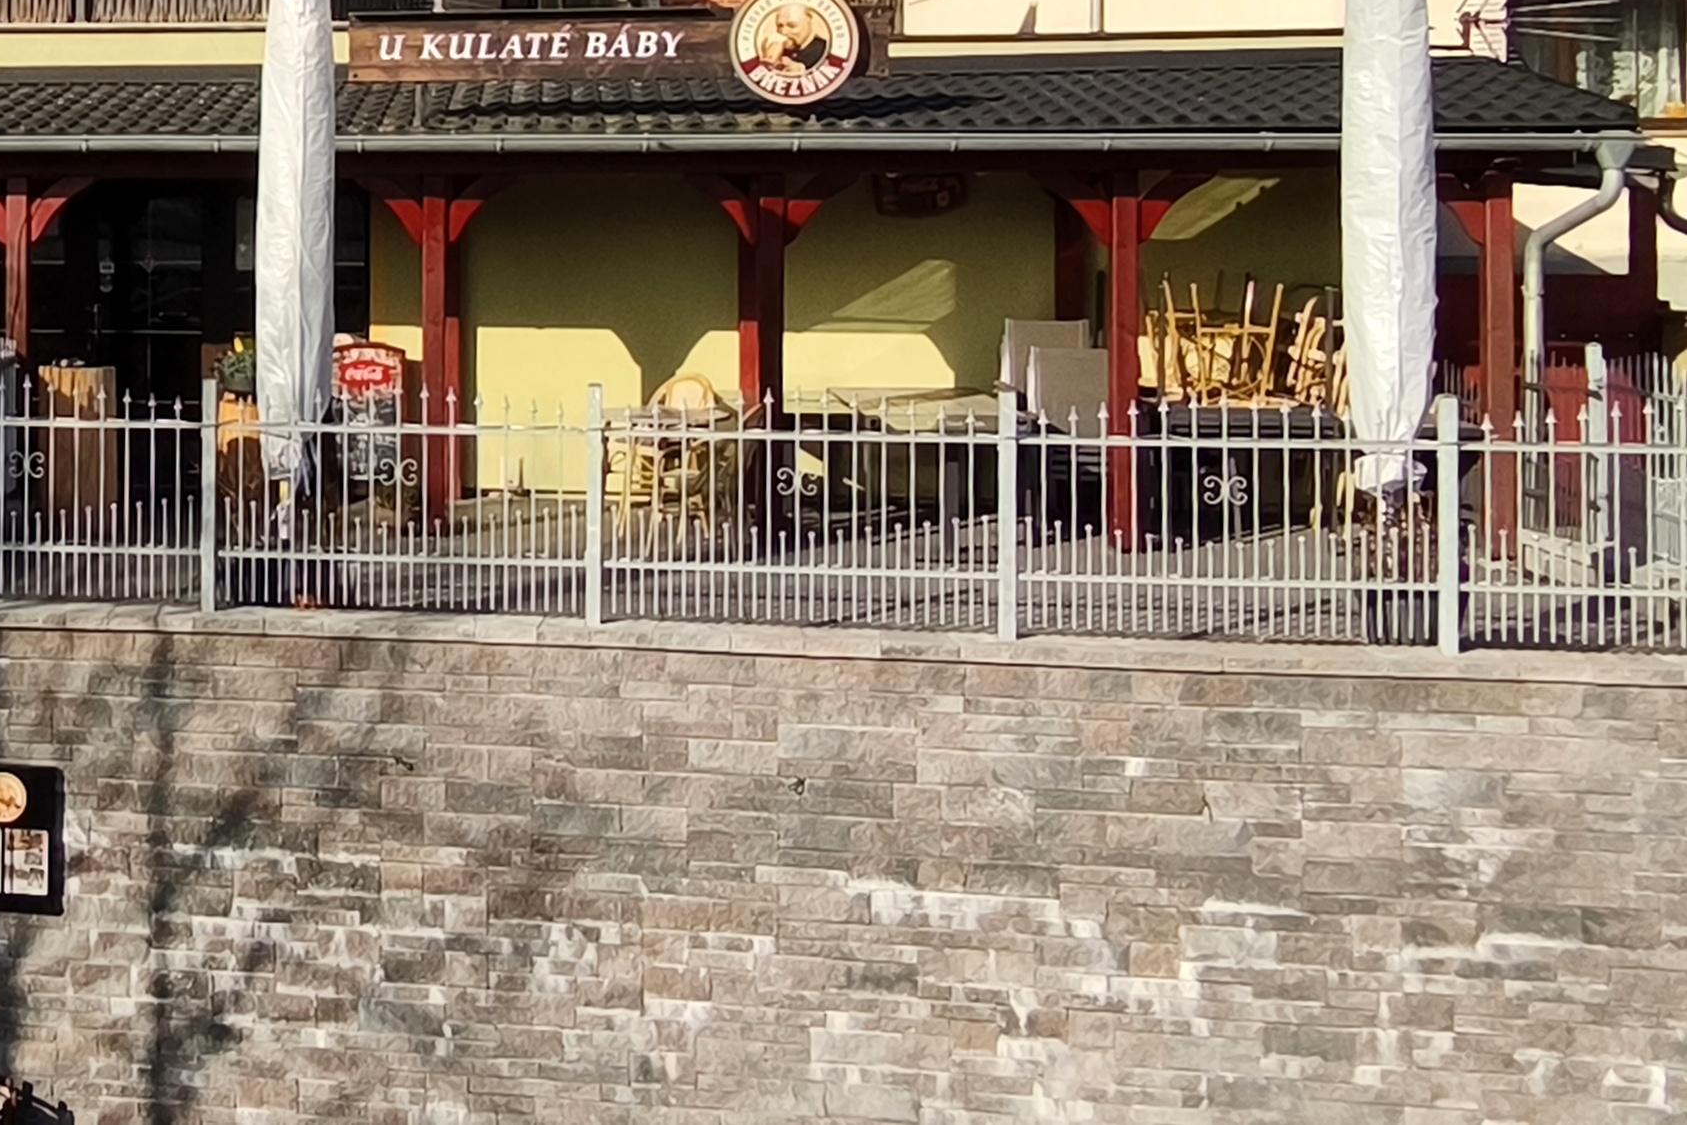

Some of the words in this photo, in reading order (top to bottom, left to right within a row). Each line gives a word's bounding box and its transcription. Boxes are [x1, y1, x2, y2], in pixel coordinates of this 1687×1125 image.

[378, 33, 406, 61] U
[418, 24, 573, 60] KULATÉ
[584, 24, 686, 58] BÁBY
